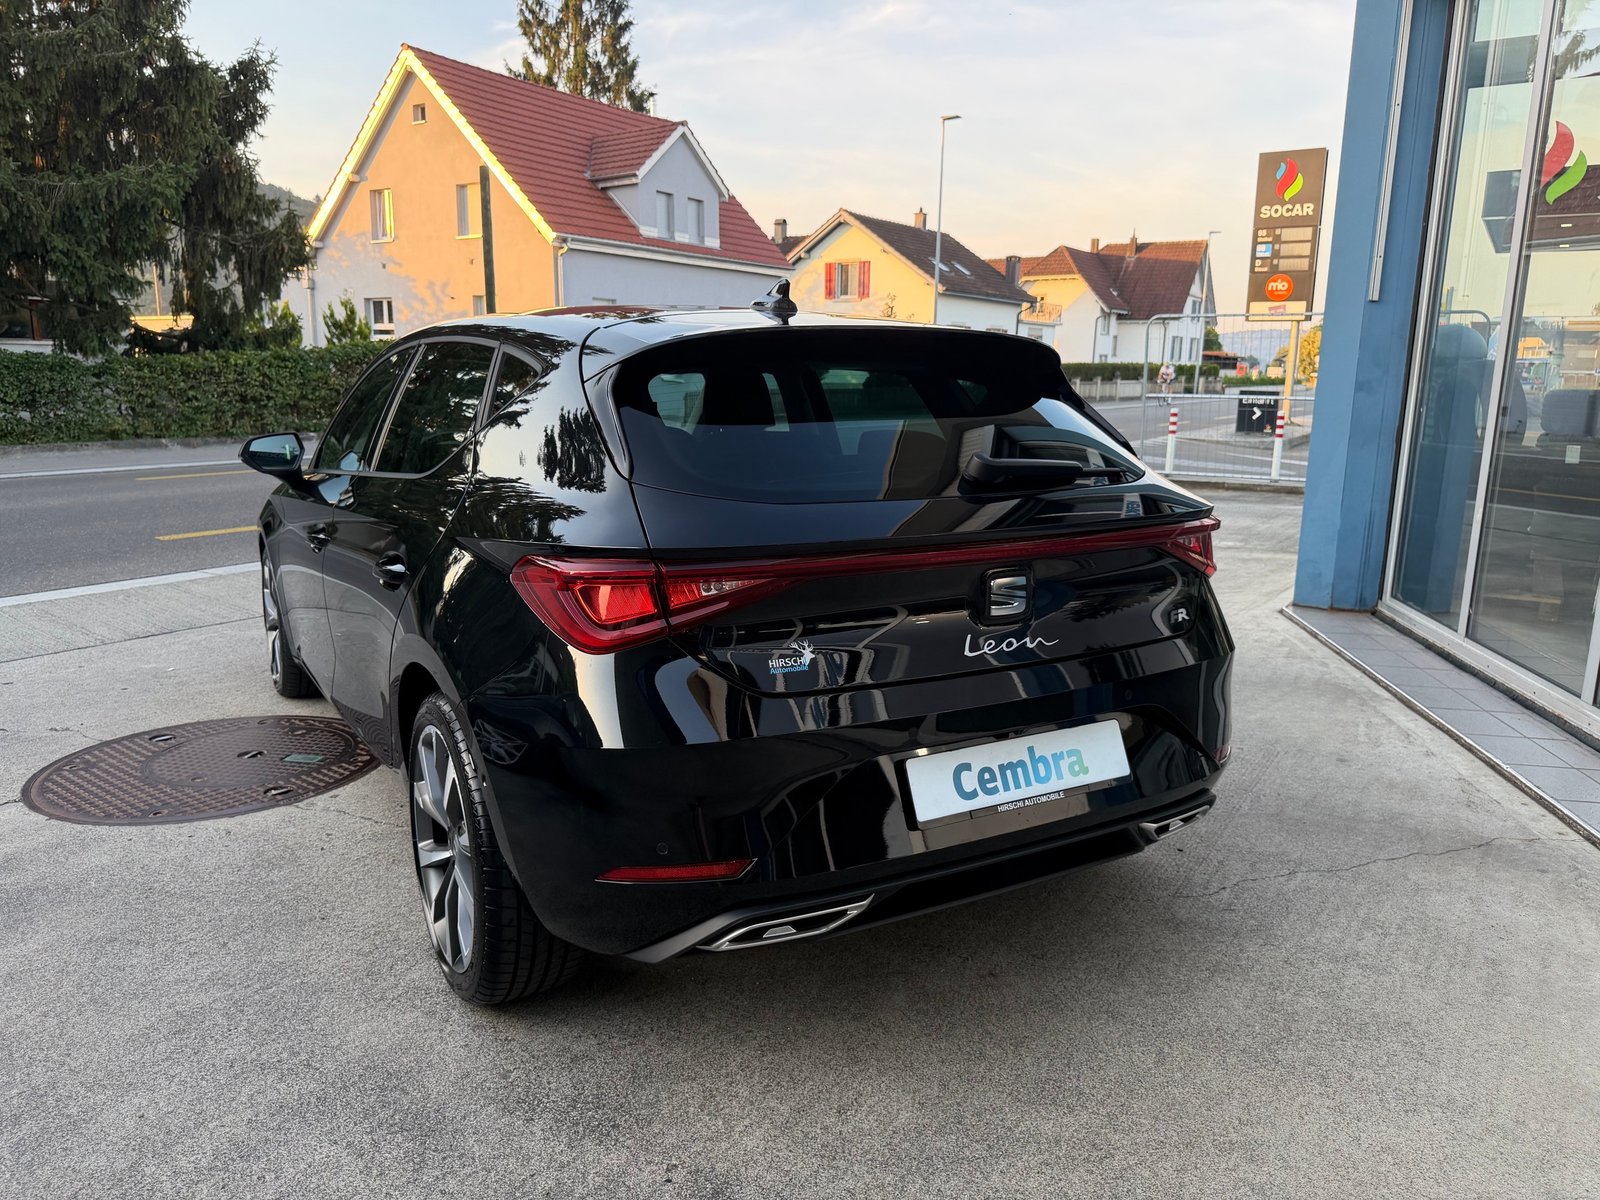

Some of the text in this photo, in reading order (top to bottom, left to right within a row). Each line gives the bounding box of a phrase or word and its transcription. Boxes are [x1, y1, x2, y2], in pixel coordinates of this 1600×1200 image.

[1259, 203, 1315, 219] SOCAR
[963, 634, 1060, 657] Leon
[770, 664, 809, 674] Automobile
[952, 745, 1089, 801] Cembra
[997, 791, 1065, 812] HIRSCHI AUTOMOBILE
